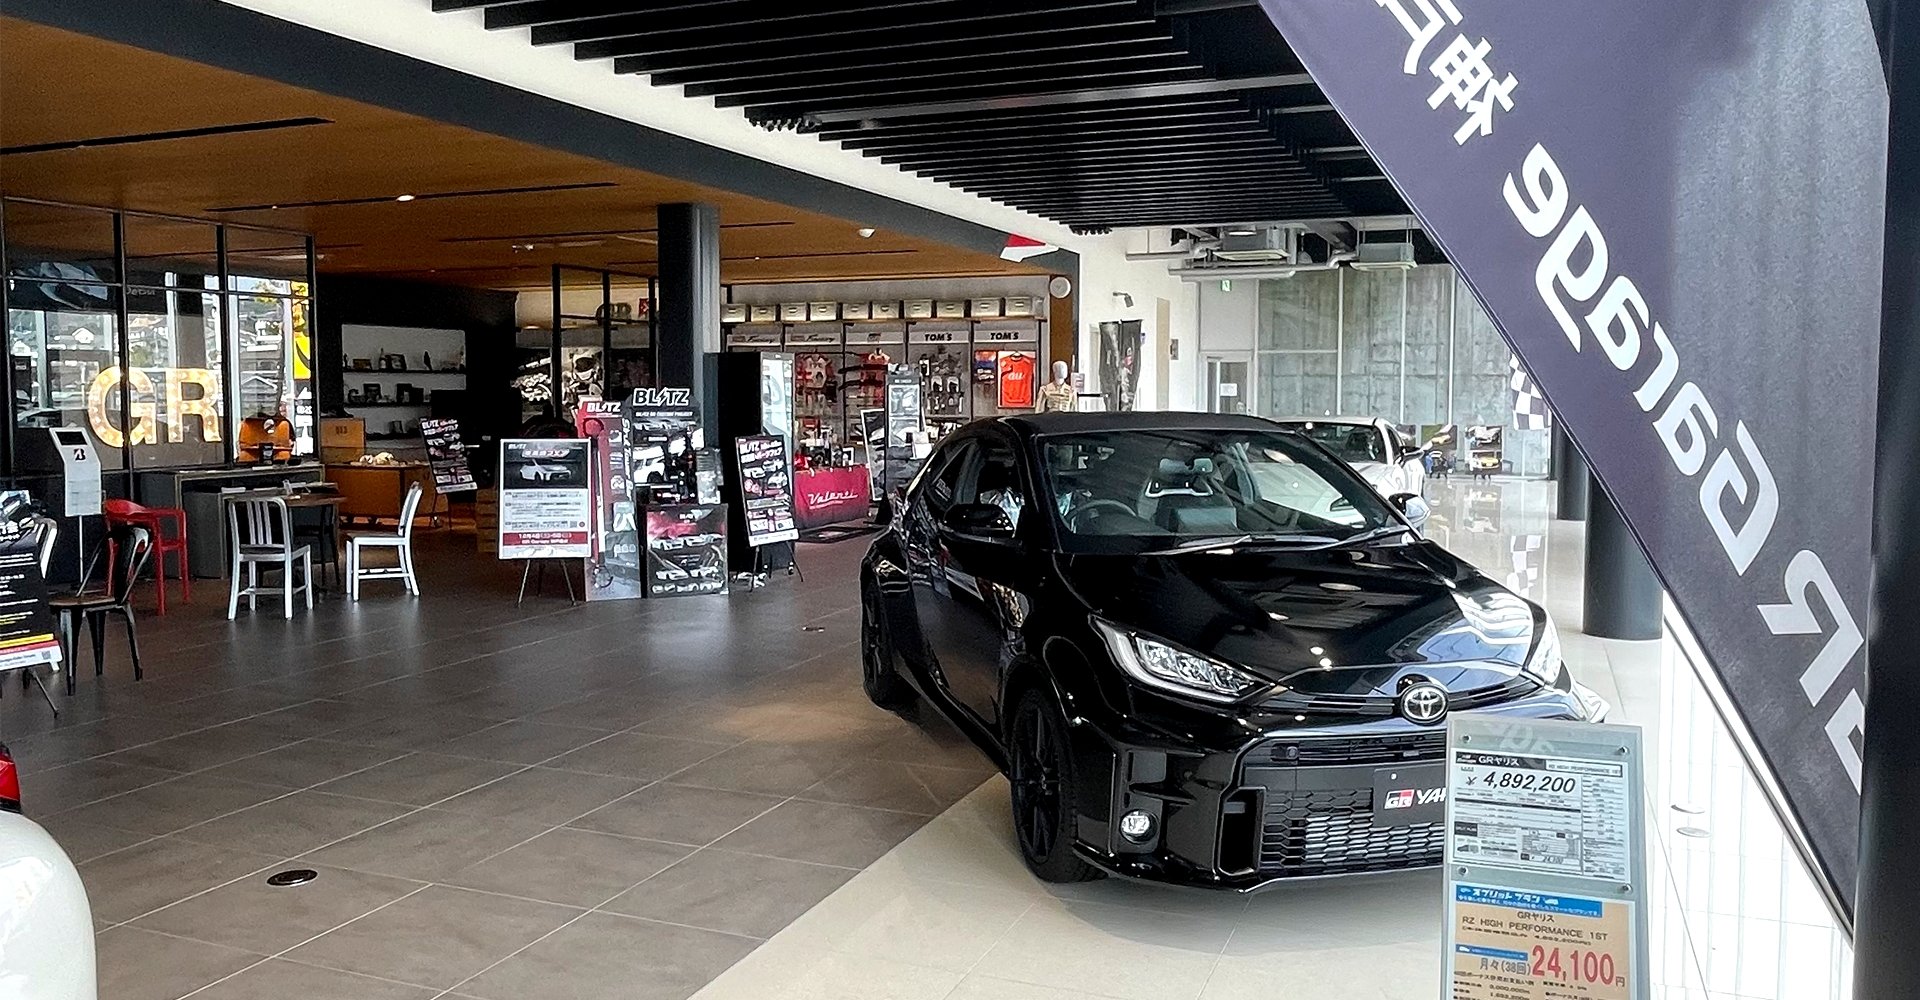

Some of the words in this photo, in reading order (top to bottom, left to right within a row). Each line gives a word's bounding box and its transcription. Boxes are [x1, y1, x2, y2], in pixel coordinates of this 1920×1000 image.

[925, 333, 952, 341] TOM'S
[990, 332, 1019, 340] TOM'S
[632, 387, 690, 407] BLITZ
[88, 366, 222, 448] GR
[587, 402, 621, 413] BLITZ
[808, 490, 859, 505] Valenti
[1478, 756, 1520, 766] GRヤリス
[1483, 771, 1576, 793] 4,892,200
[1472, 888, 1512, 899] スプリット
[1514, 892, 1541, 903] プラン
[1517, 911, 1555, 923] GRヤリス
[1462, 916, 1475, 925] RZ
[1480, 919, 1504, 928] HIGH
[1508, 921, 1583, 938] PERFORMANCE
[1589, 931, 1608, 941] 1ST
[1532, 944, 1614, 986] 24,100
